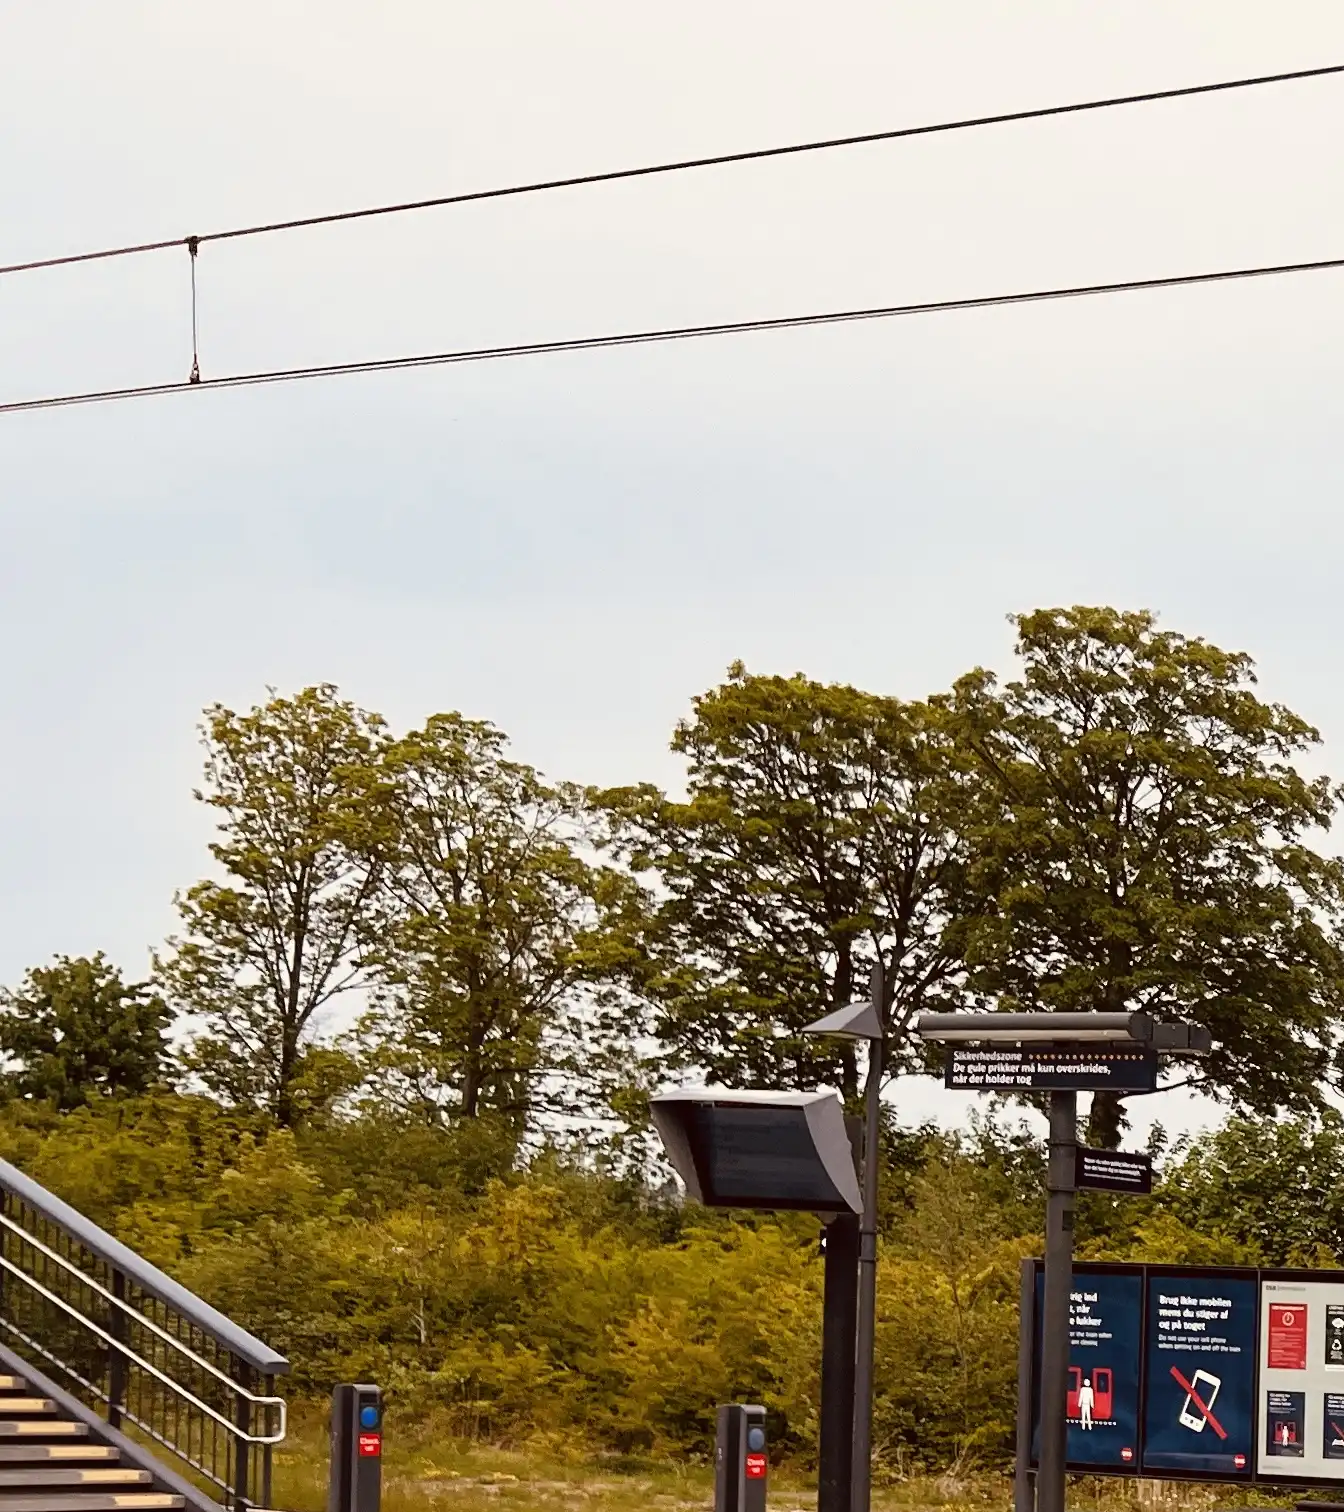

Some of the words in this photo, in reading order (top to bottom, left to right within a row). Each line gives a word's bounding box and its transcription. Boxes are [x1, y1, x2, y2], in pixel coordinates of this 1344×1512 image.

[953, 1051, 1022, 1061] Sikkerhedszone
[953, 1063, 966, 1073] De
[967, 1063, 986, 1074] gule
[988, 1063, 1019, 1074] prikker
[1022, 1063, 1035, 1073] må
[1038, 1063, 1054, 1073] kun
[1056, 1063, 1111, 1075] overskrides,
[952, 1074, 967, 1084] når
[969, 1074, 984, 1084] der
[986, 1074, 1014, 1085] holder
[1016, 1075, 1032, 1086] tog
[1084, 1293, 1097, 1302] ind
[1160, 1295, 1179, 1306] Brug
[1180, 1296, 1198, 1306] ikke
[1199, 1298, 1232, 1307] mobilen
[1159, 1309, 1181, 1317] mens
[1183, 1308, 1194, 1317] du
[1196, 1310, 1219, 1320] stiger
[1220, 1310, 1228, 1319] af
[1159, 1321, 1170, 1330] og
[1171, 1320, 1182, 1330] på
[1184, 1322, 1205, 1331] toget
